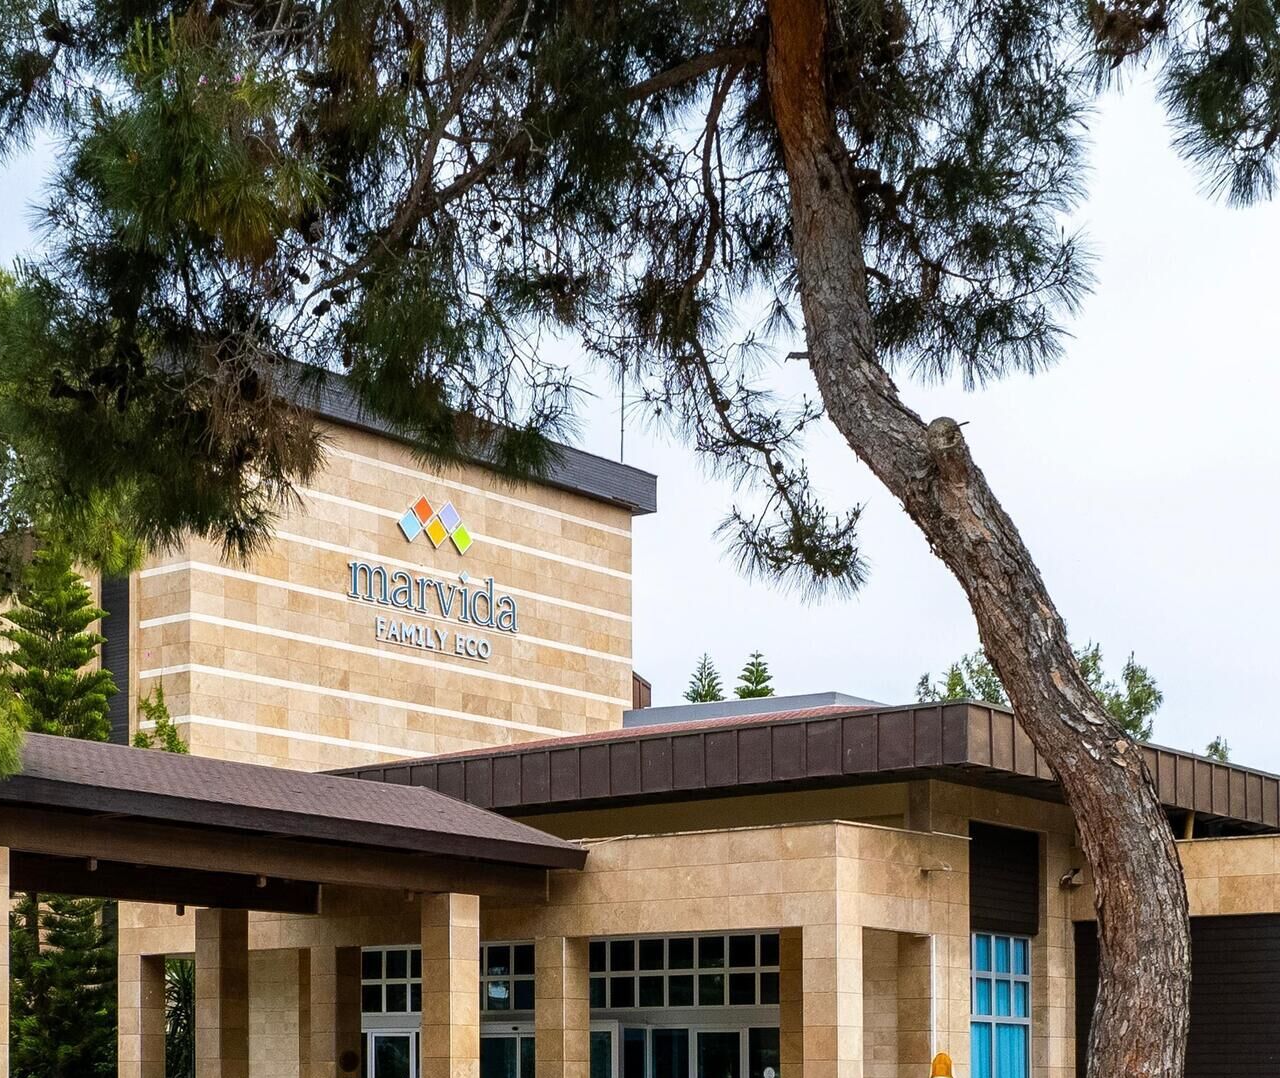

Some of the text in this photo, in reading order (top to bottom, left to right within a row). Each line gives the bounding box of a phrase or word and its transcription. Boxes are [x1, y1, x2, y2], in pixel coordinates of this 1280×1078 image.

[348, 561, 519, 633] marvida
[376, 616, 491, 659] FAMILY ECO
